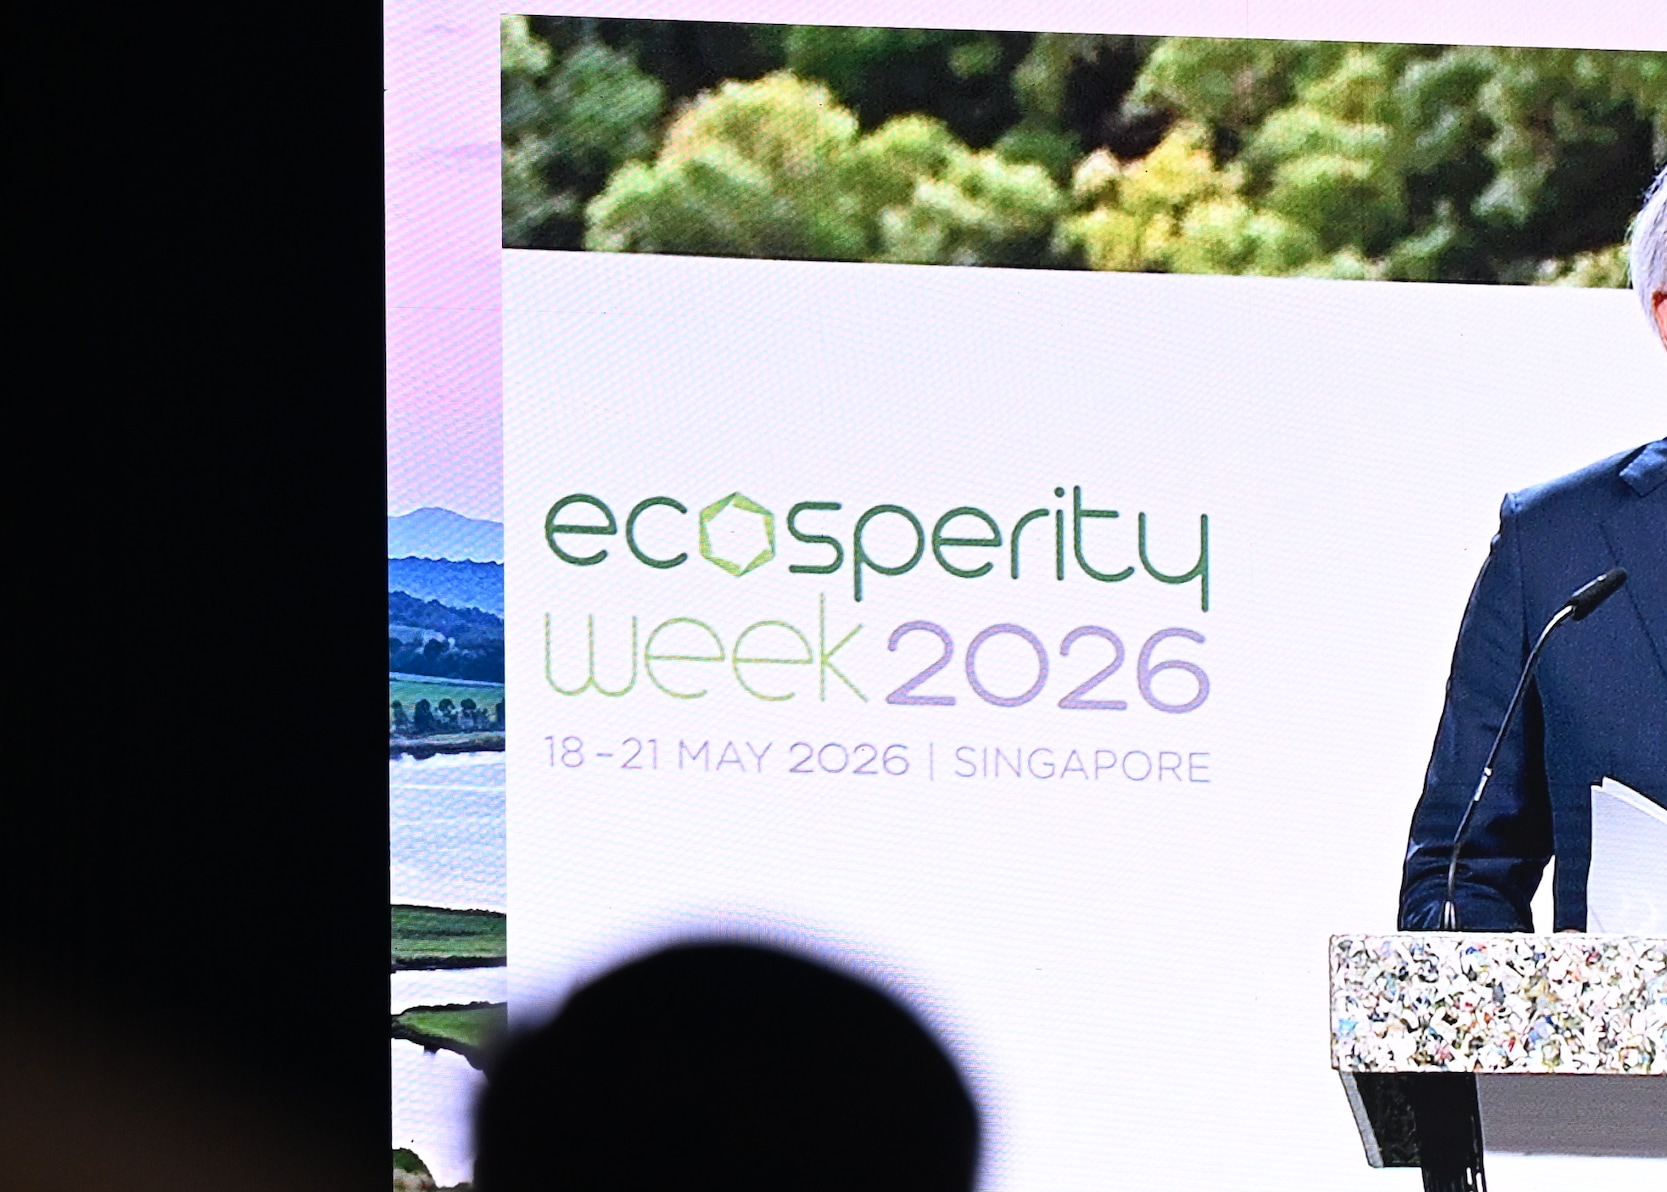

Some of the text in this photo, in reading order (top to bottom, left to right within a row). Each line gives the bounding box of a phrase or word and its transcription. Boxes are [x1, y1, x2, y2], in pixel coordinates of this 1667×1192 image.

[543, 484, 1210, 613] ecosperity
[678, 739, 773, 773] MAY
[788, 741, 910, 777] 2026
[954, 745, 1211, 784] SINGAPORE
